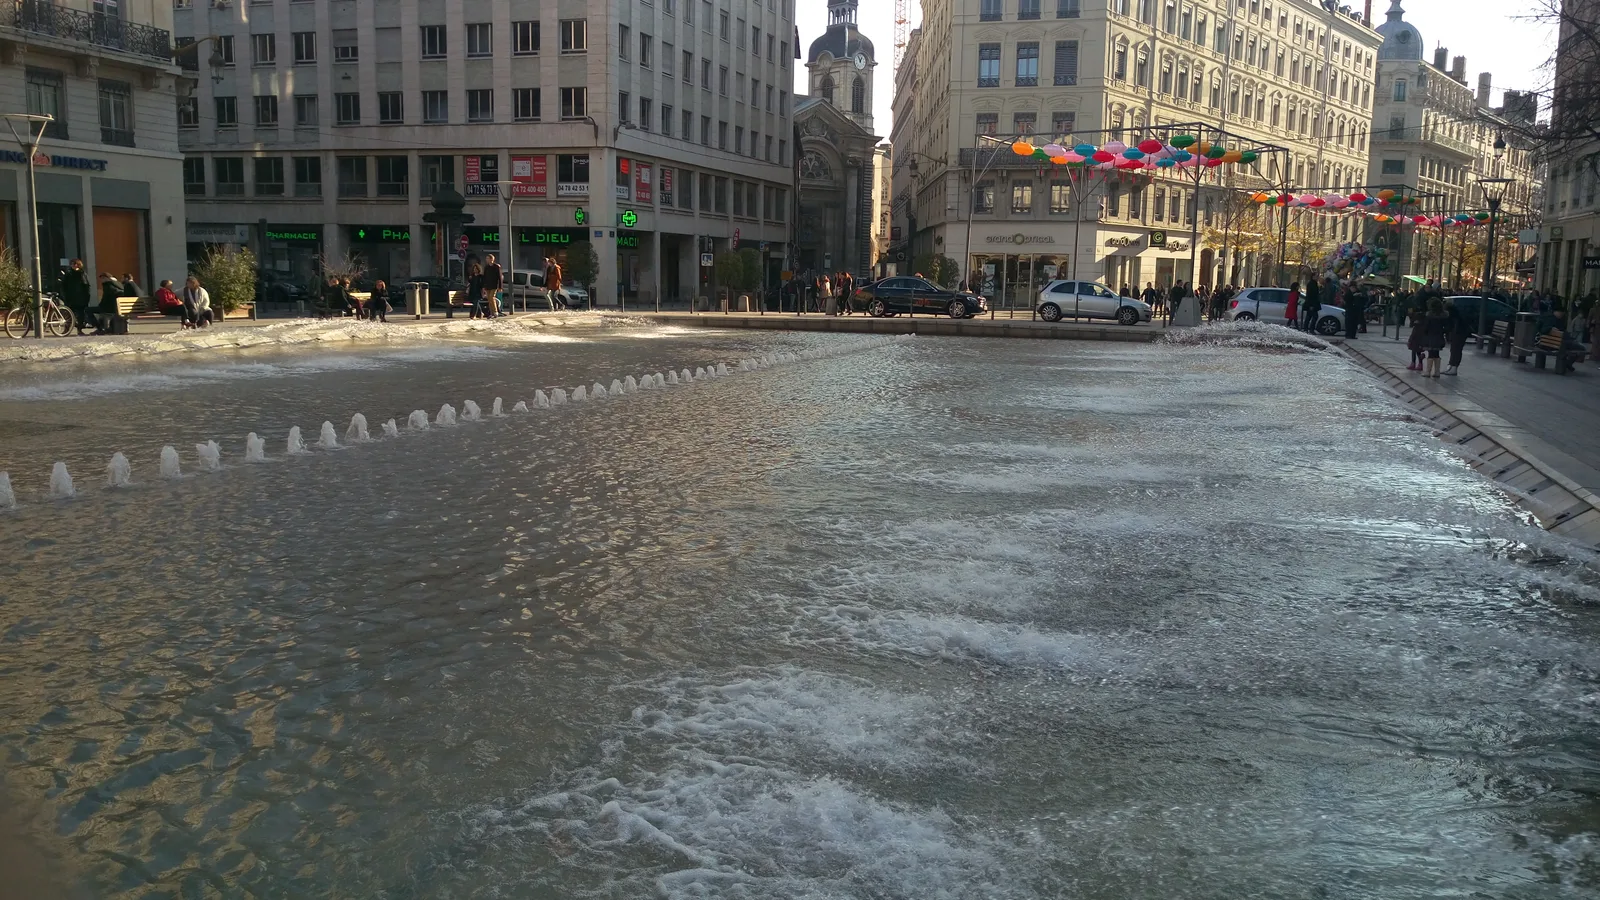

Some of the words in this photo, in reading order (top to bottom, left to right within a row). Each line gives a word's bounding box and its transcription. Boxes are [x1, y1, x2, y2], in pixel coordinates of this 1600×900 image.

[52, 155, 108, 171] DIRECT
[266, 231, 317, 240] PHARMACIE
[536, 233, 569, 243] DIEU
